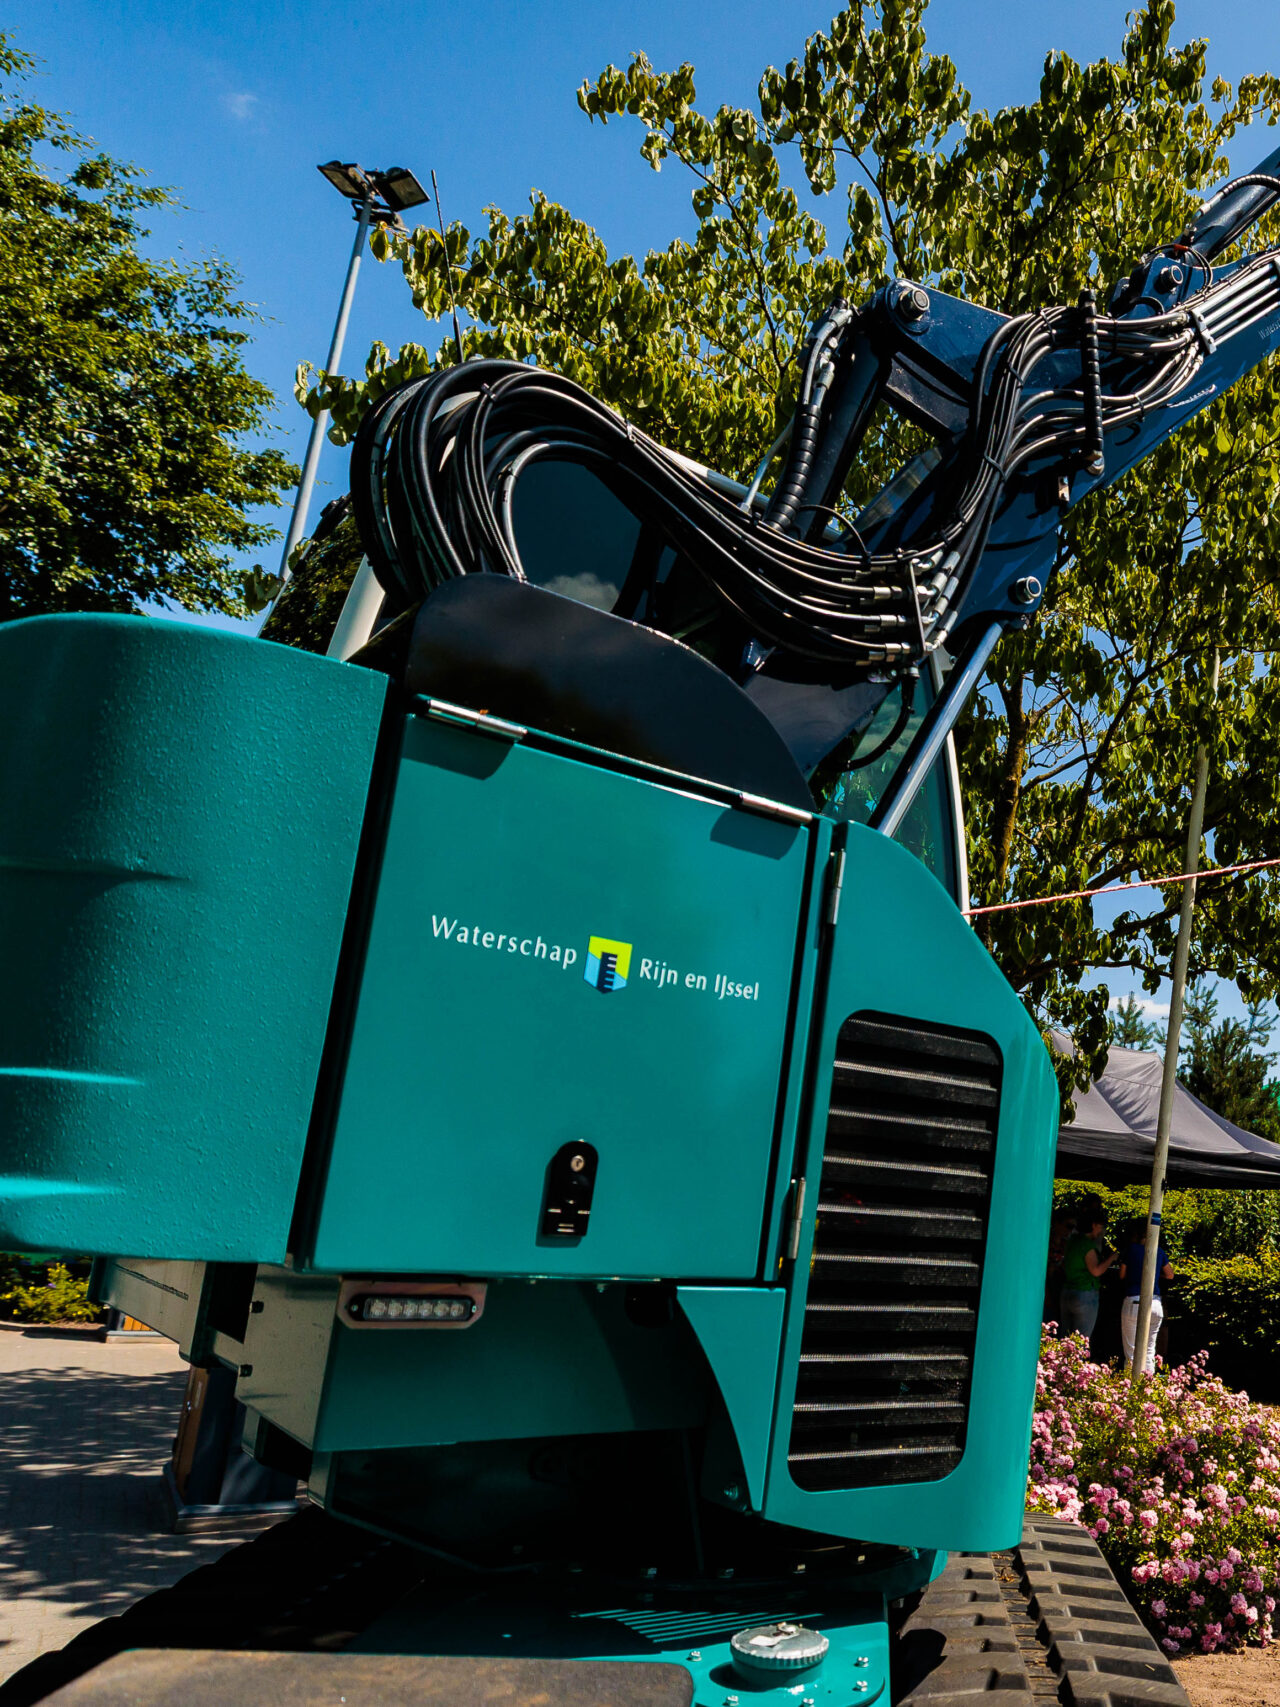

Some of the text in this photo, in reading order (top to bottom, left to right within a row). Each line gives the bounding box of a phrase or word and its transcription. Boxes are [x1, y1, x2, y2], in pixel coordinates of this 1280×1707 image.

[432, 914, 760, 1000] Waterschap Rijn en IJssel
